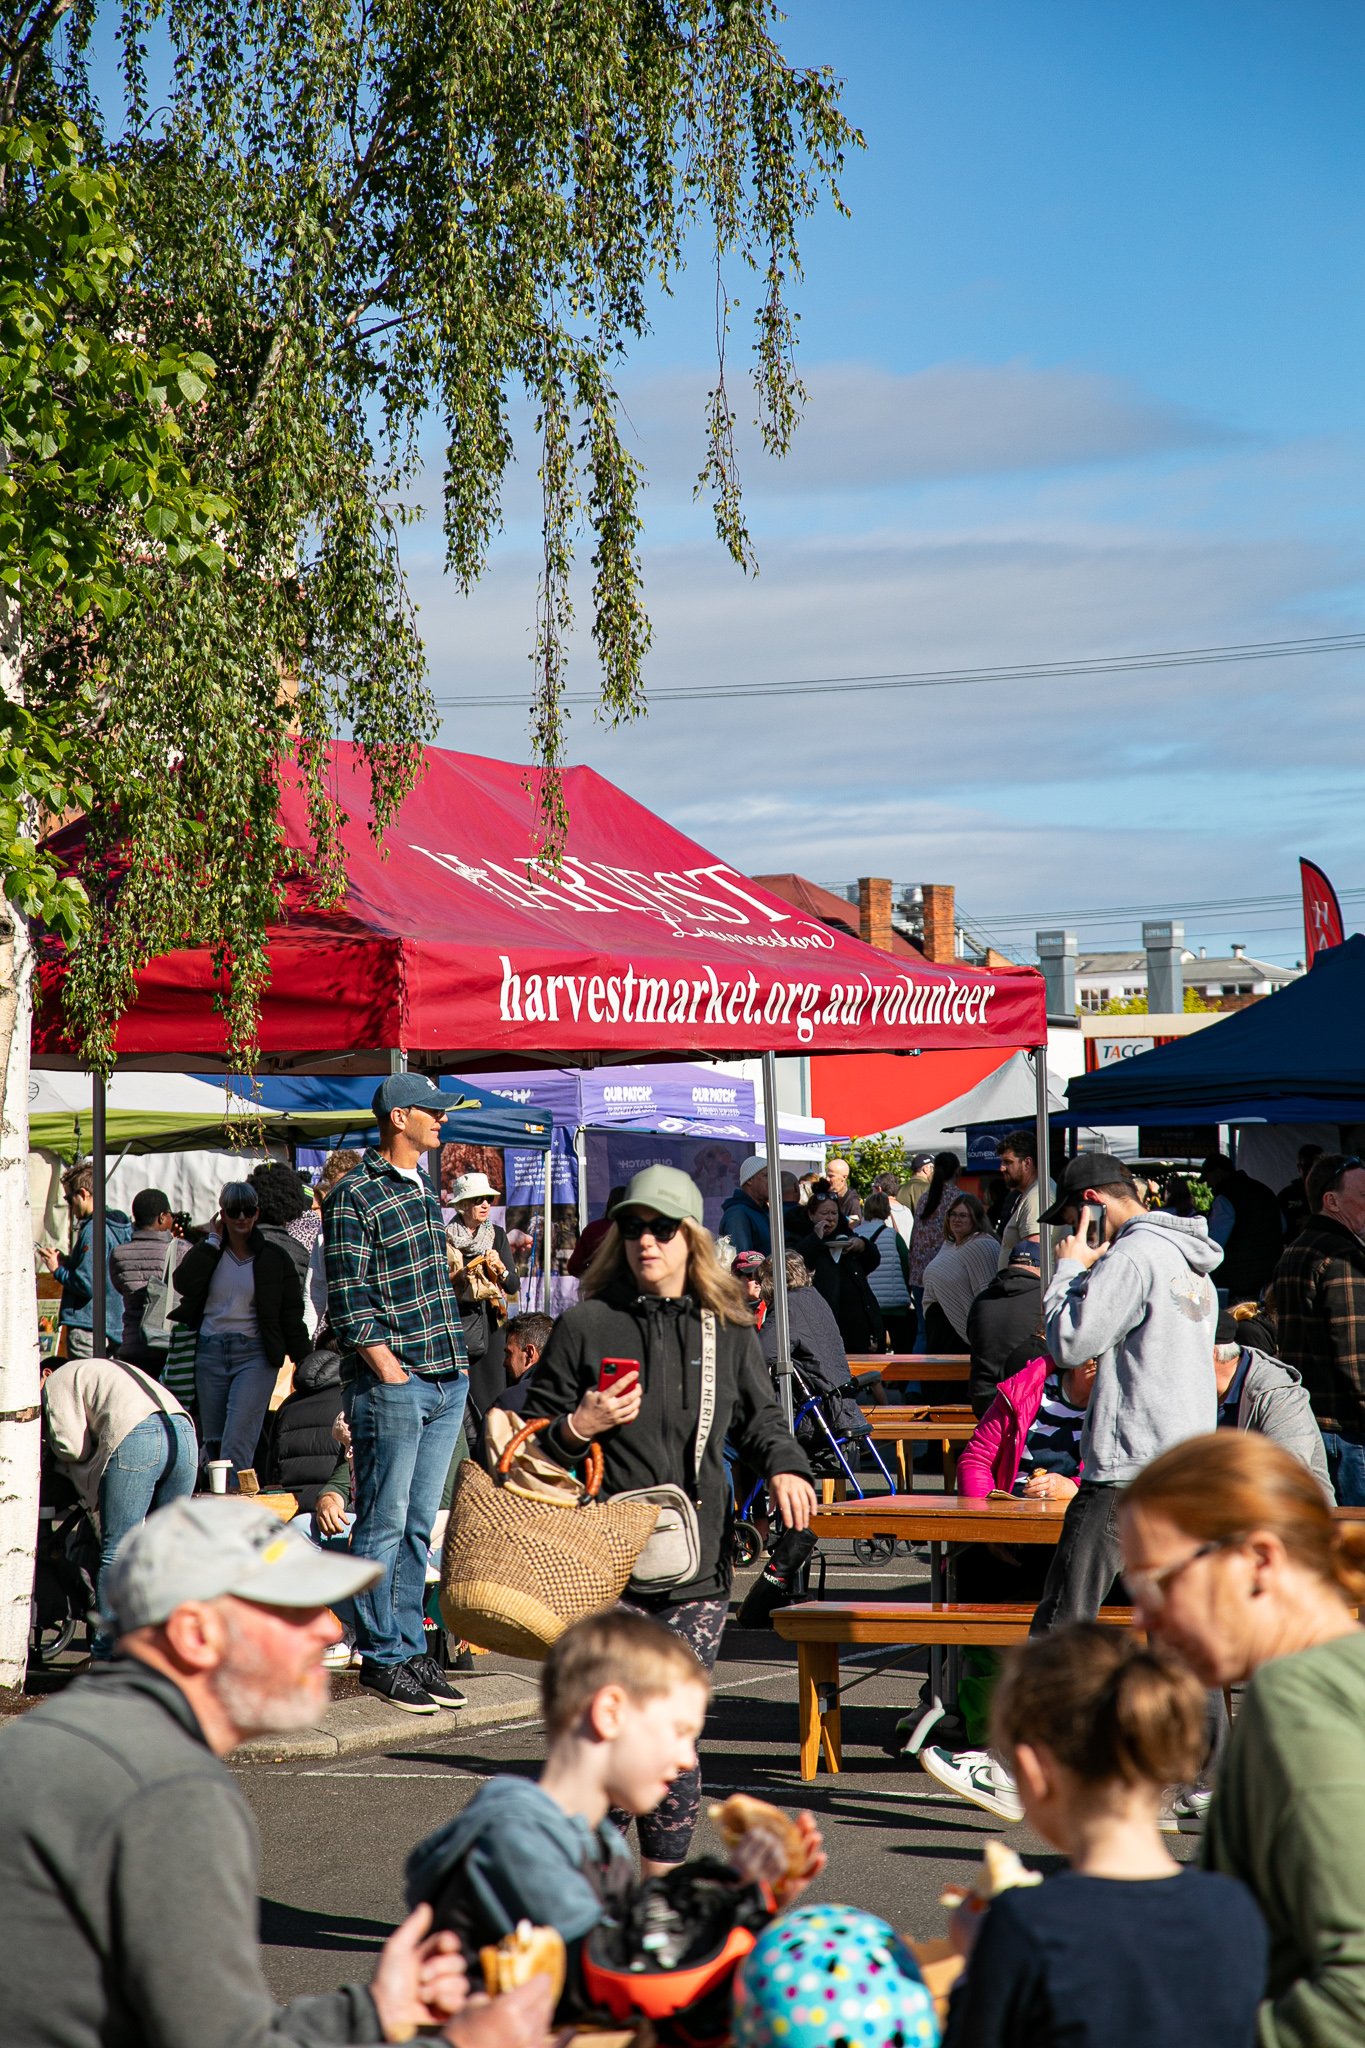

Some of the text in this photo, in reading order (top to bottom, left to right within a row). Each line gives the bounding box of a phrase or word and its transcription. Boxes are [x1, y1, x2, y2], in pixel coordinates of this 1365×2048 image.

[408, 844, 791, 925] HARVEST
[643, 908, 835, 949] Launceston
[498, 955, 996, 1043] harvestmarket.org.au/volunteer
[603, 1086, 652, 1102] OUR PATCH
[692, 1087, 737, 1103] OUR PATCH
[704, 1347, 714, 1384] SEED
[696, 1388, 713, 1463] HERITAGE
